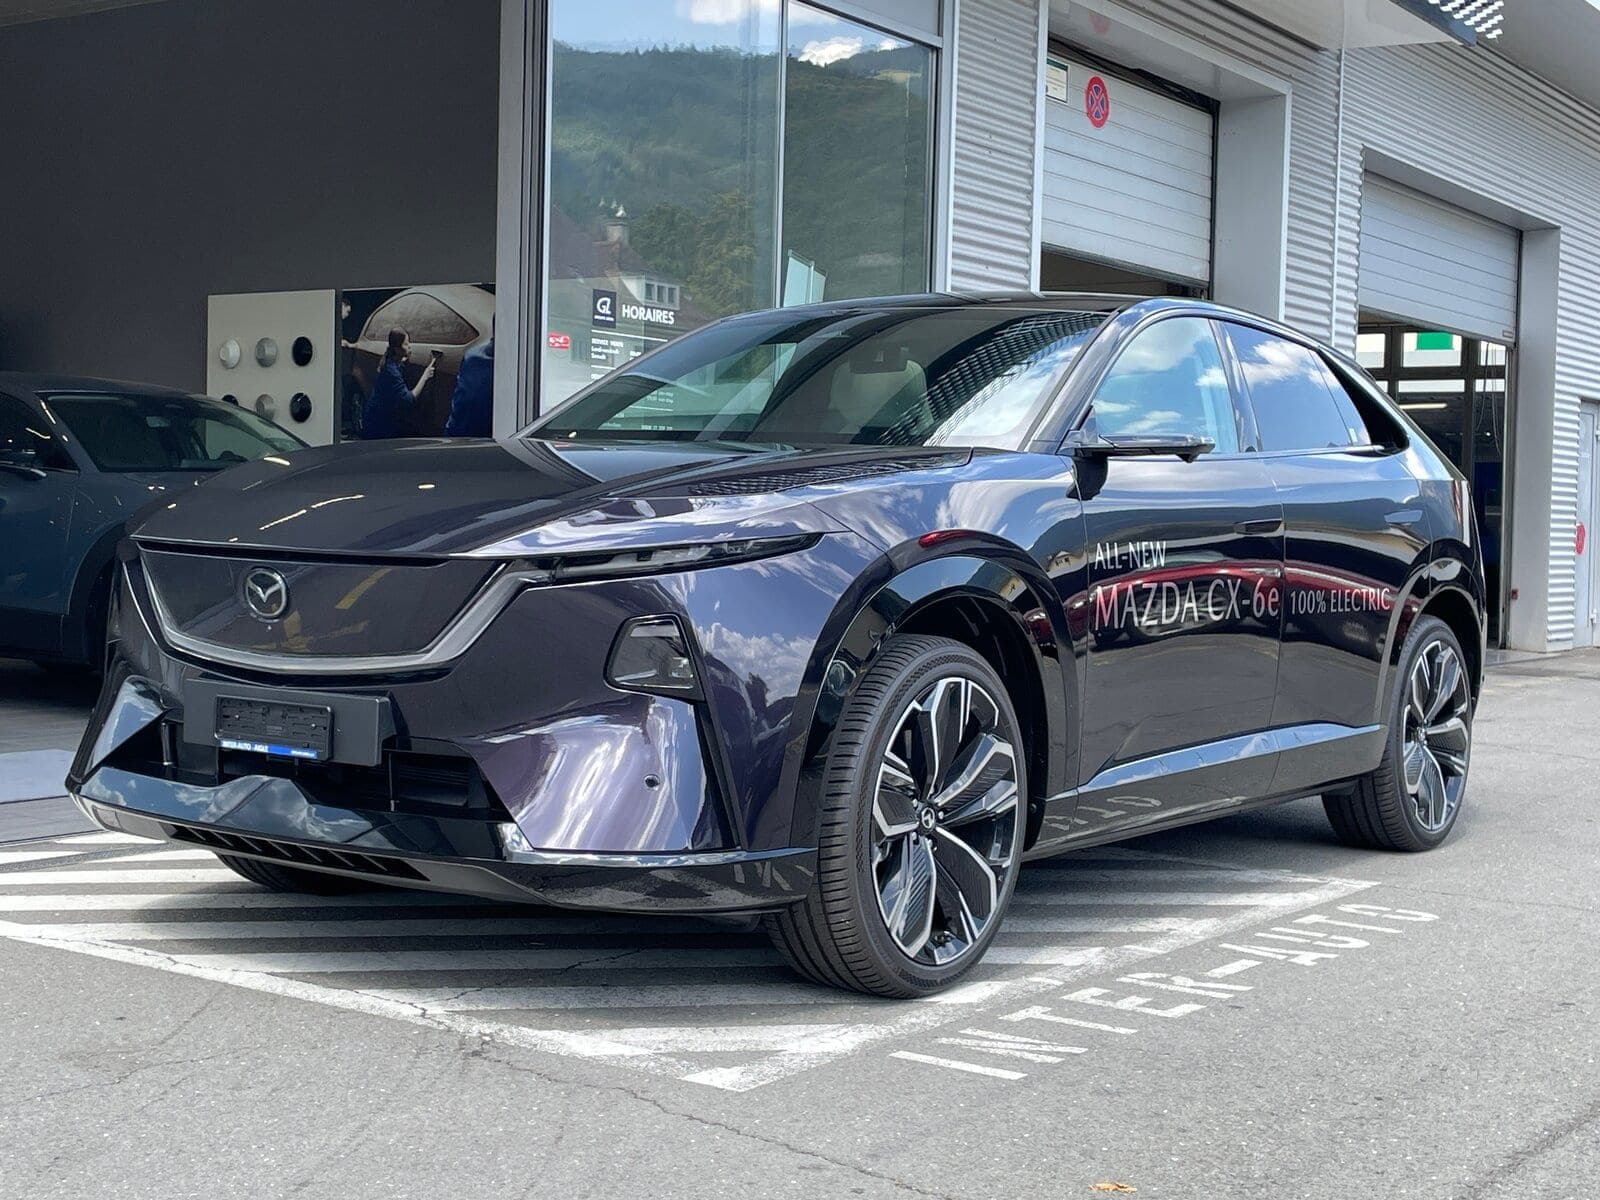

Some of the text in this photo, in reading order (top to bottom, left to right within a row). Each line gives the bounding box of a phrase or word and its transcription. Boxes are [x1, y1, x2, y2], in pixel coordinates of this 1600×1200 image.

[621, 304, 675, 325] HORAIRES
[1094, 541, 1167, 570] ALL-NEW
[1094, 577, 1280, 631] MAZDA CX-6e
[1290, 588, 1391, 615] 100% ELECTRIC
[888, 904, 1440, 1081] INTER-AUTO
